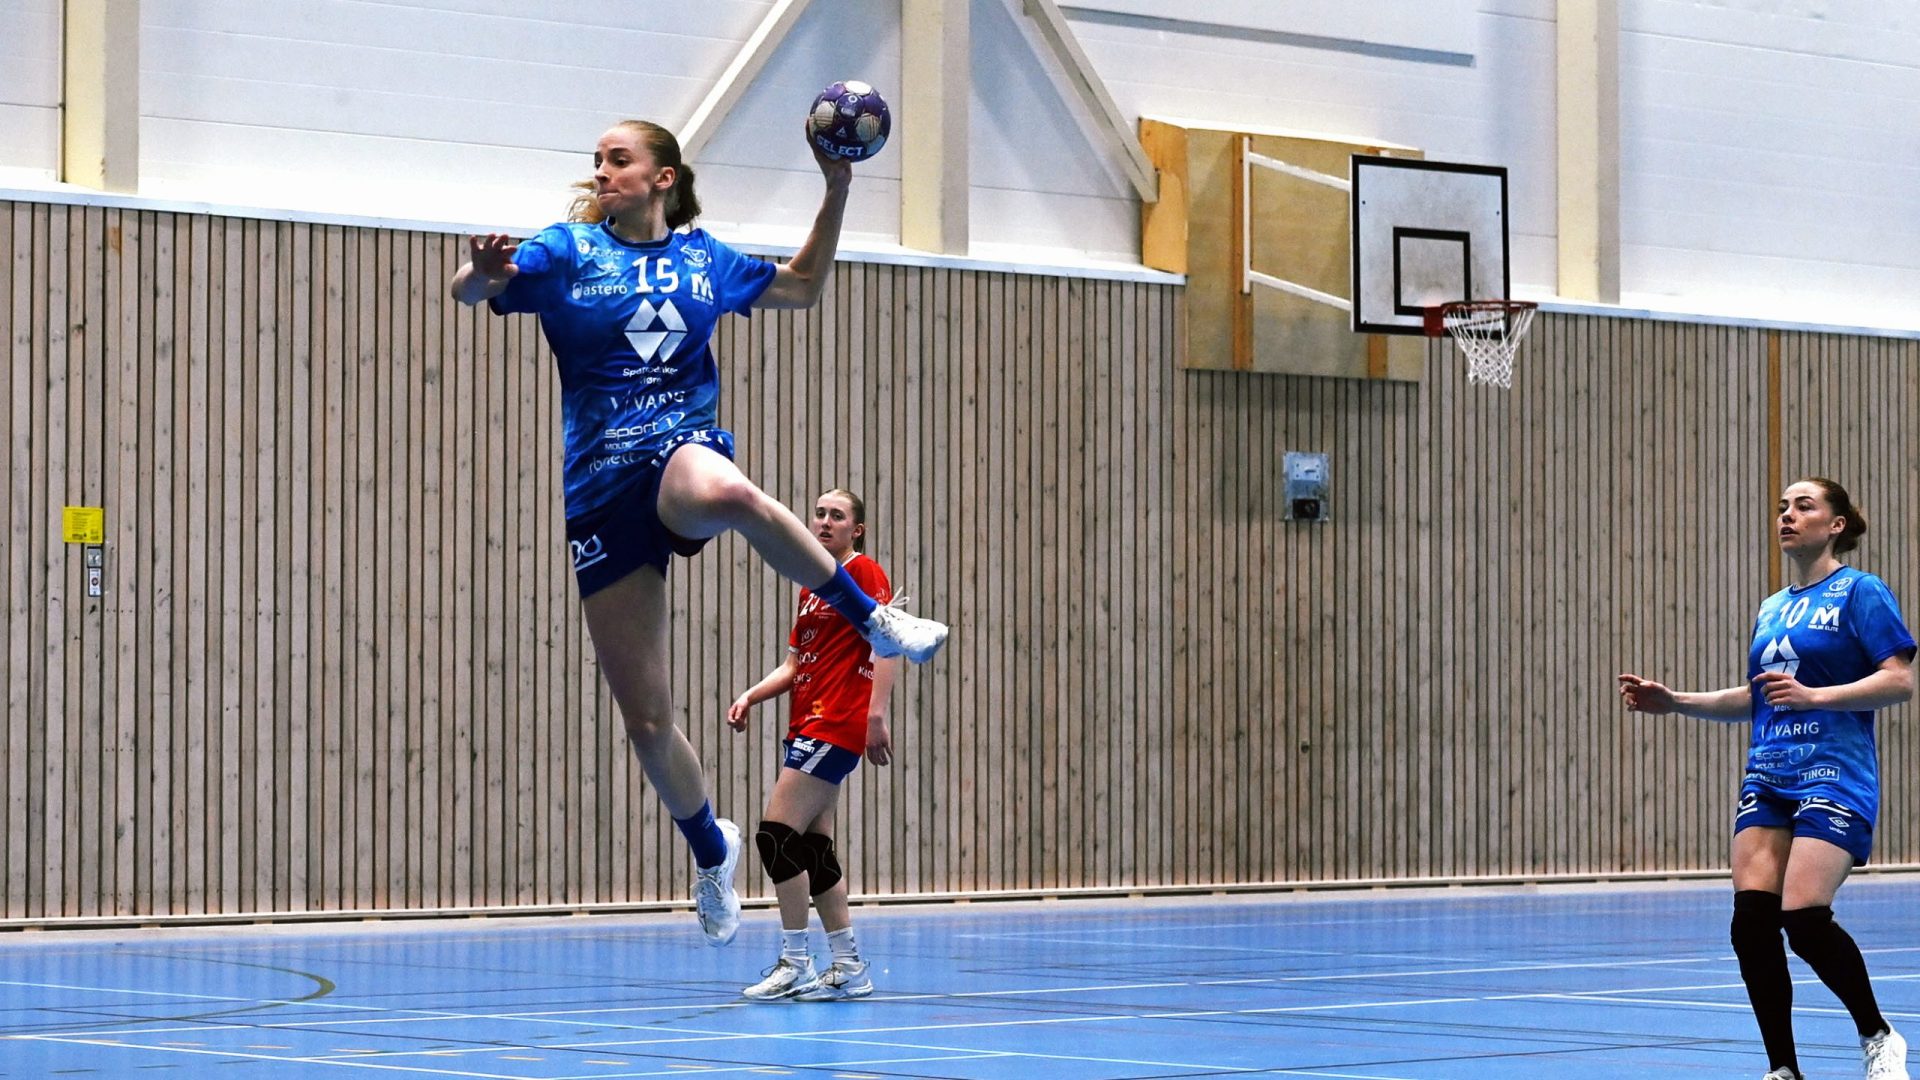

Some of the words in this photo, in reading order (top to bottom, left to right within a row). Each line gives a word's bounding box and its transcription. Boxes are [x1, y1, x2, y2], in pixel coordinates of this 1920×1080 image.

[816, 135, 864, 156] SELECT
[632, 255, 679, 294] 15
[583, 283, 628, 296] astero
[1822, 590, 1848, 599] TOYOTA
[1779, 596, 1810, 629] 10
[1775, 721, 1820, 737] VARIG
[1801, 767, 1836, 782] TINGH
